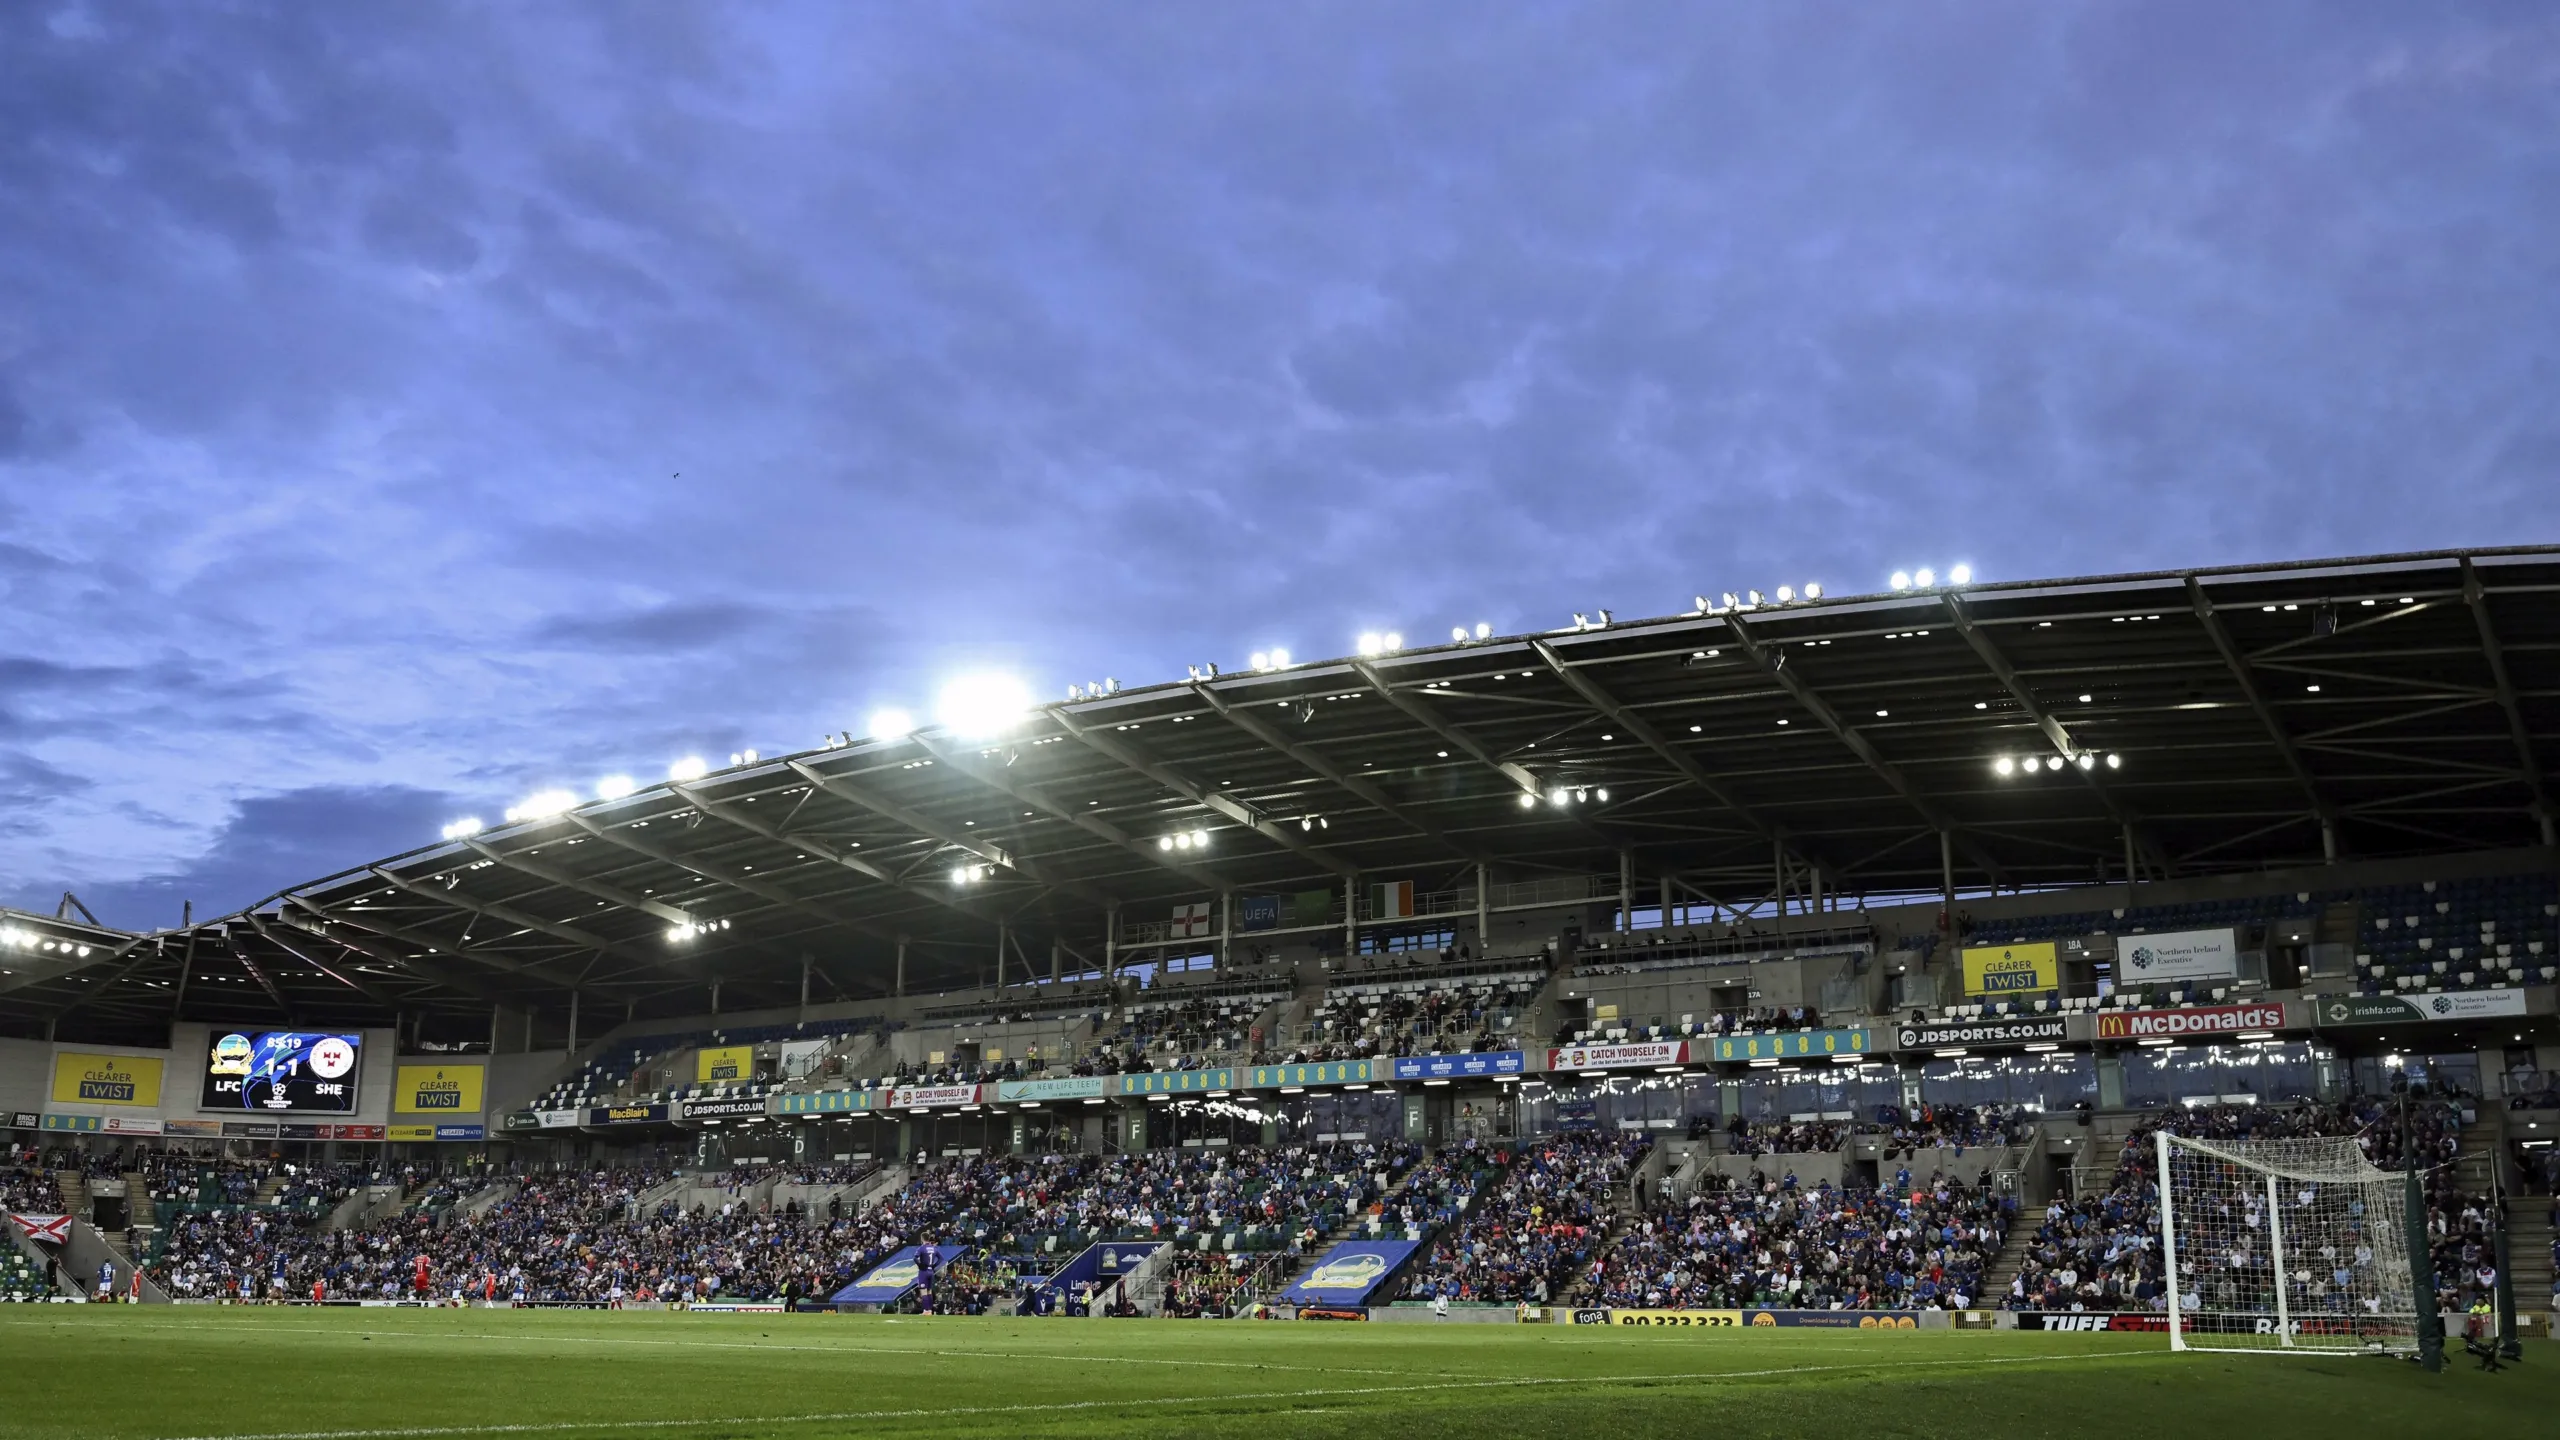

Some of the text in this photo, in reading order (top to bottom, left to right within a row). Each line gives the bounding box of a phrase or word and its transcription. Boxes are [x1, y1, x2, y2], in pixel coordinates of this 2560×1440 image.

[1245, 908, 1275, 921] UEFA
[2067, 940, 2082, 950] 18A
[2156, 944, 2222, 956] Northern Ireland
[1985, 960, 2033, 973] CLEARER
[2157, 957, 2194, 965] Executive
[1986, 973, 2034, 989] TWIST
[1748, 991, 1761, 999] 17A
[2454, 994, 2511, 1004] Northern Ireland
[2355, 1005, 2405, 1016] irishfa.com
[2455, 1003, 2486, 1011] Executive
[2130, 1009, 2280, 1034] McDonald's
[1918, 1023, 2064, 1043] JDSPORTS.CO.UK
[266, 1037, 302, 1049] 85:19
[1591, 1045, 1669, 1060] CATCH YOURSELF ON
[265, 1058, 298, 1076] 1-1
[713, 1059, 736, 1067] CLEARER
[84, 1071, 132, 1083] CLEARER
[713, 1067, 737, 1079] TWIST
[83, 1083, 131, 1098] TWIST
[215, 1080, 241, 1092] LFC
[315, 1084, 343, 1095] SHE
[419, 1081, 458, 1090] CLEARER
[1056, 1081, 1073, 1090] LIFE
[1077, 1080, 1101, 1088] TEETH
[915, 1087, 969, 1099] CATCH YOURSELF ON
[1904, 1086, 1920, 1106] H
[418, 1093, 458, 1106] TWIST
[609, 1107, 645, 1119] MacBlair
[693, 1101, 765, 1114] JDSPORTS.CO.UK
[17, 1114, 37, 1122] BRICK
[1409, 1111, 1418, 1127] F
[1013, 1129, 1022, 1145] E
[1132, 1124, 1140, 1139] F
[698, 1144, 706, 1158] C
[795, 1140, 804, 1154] D
[2002, 1176, 2012, 1189] H
[78, 1207, 92, 1215] AA
[928, 1253, 933, 1265] 1
[272, 1261, 277, 1271] 3
[417, 1262, 424, 1272] 11
[104, 1269, 112, 1277] 17
[1579, 1310, 1603, 1323] fona
[2042, 1315, 2109, 1331] TUFF
